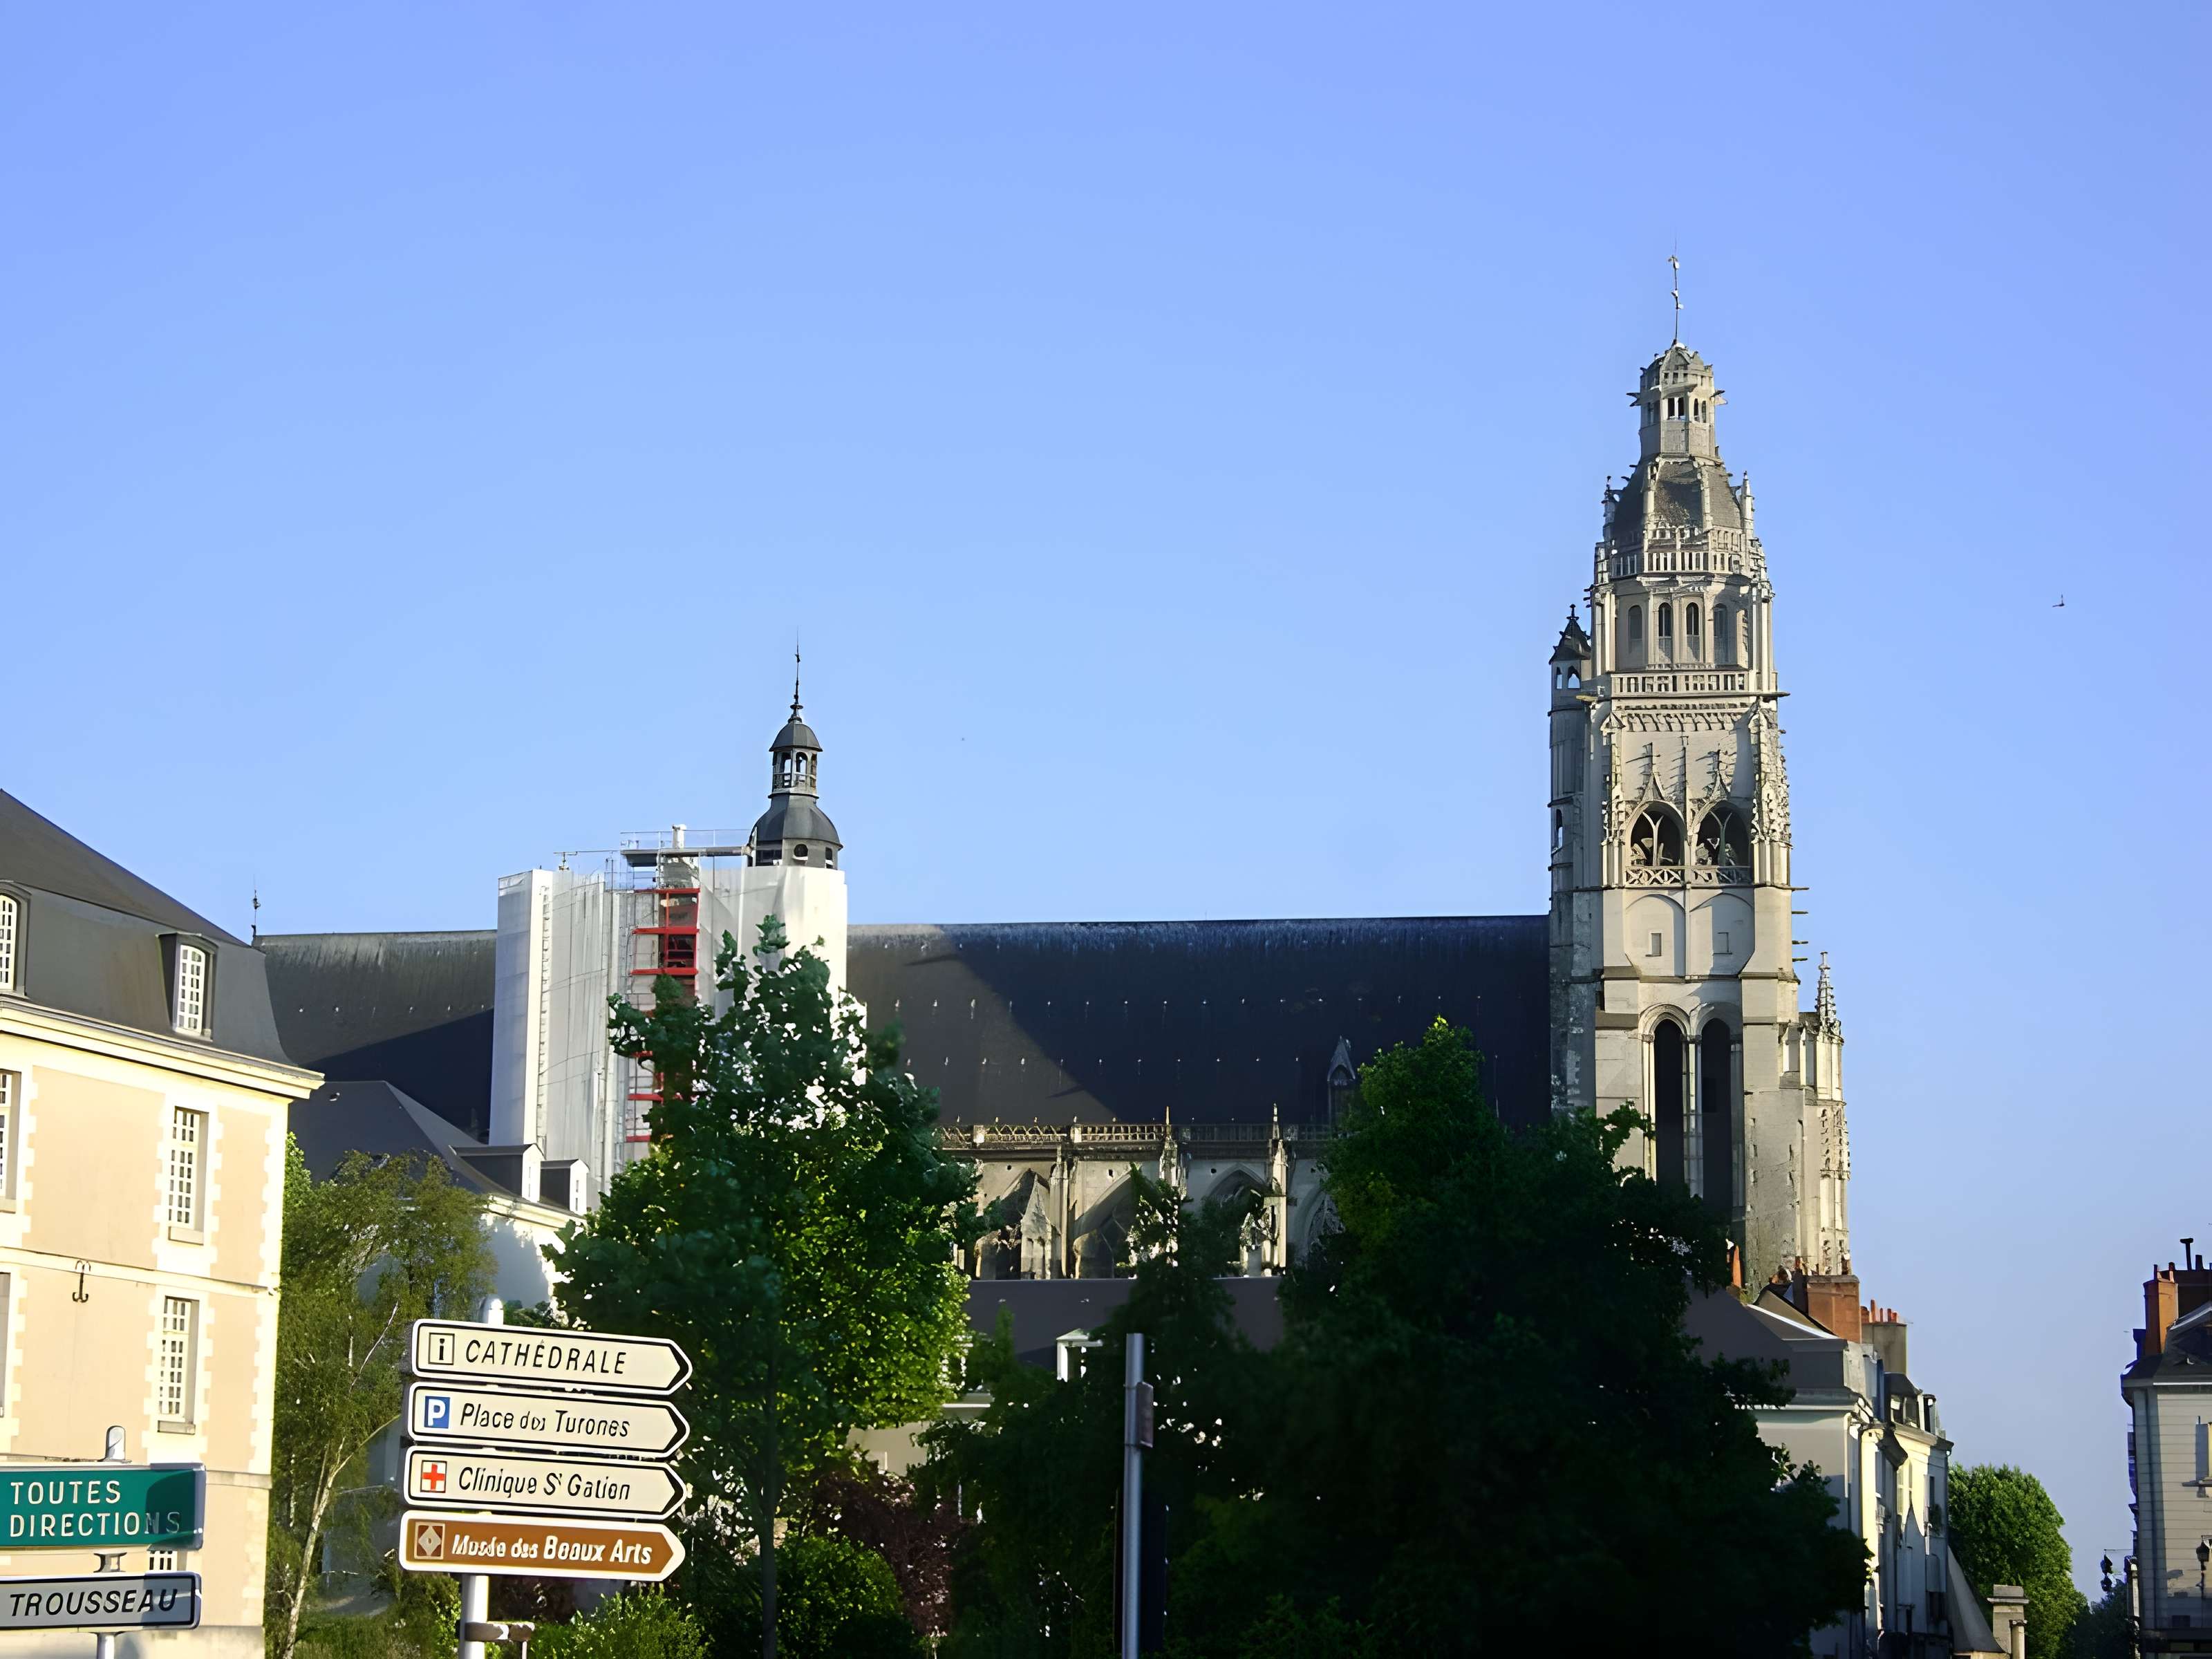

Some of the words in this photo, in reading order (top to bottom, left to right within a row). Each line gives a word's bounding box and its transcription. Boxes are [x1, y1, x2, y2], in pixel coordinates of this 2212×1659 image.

[465, 1339, 627, 1374] CATHÉDRALE
[460, 1403, 514, 1429] Place
[554, 1409, 630, 1437] Turones
[10, 1480, 122, 1505] TOUTES
[458, 1466, 538, 1499] Clinique
[10, 1511, 181, 1537] DIRECTIONS
[543, 1535, 606, 1562] Beaux
[609, 1539, 653, 1564] Arts
[10, 1588, 178, 1617] TROUSSEAU
